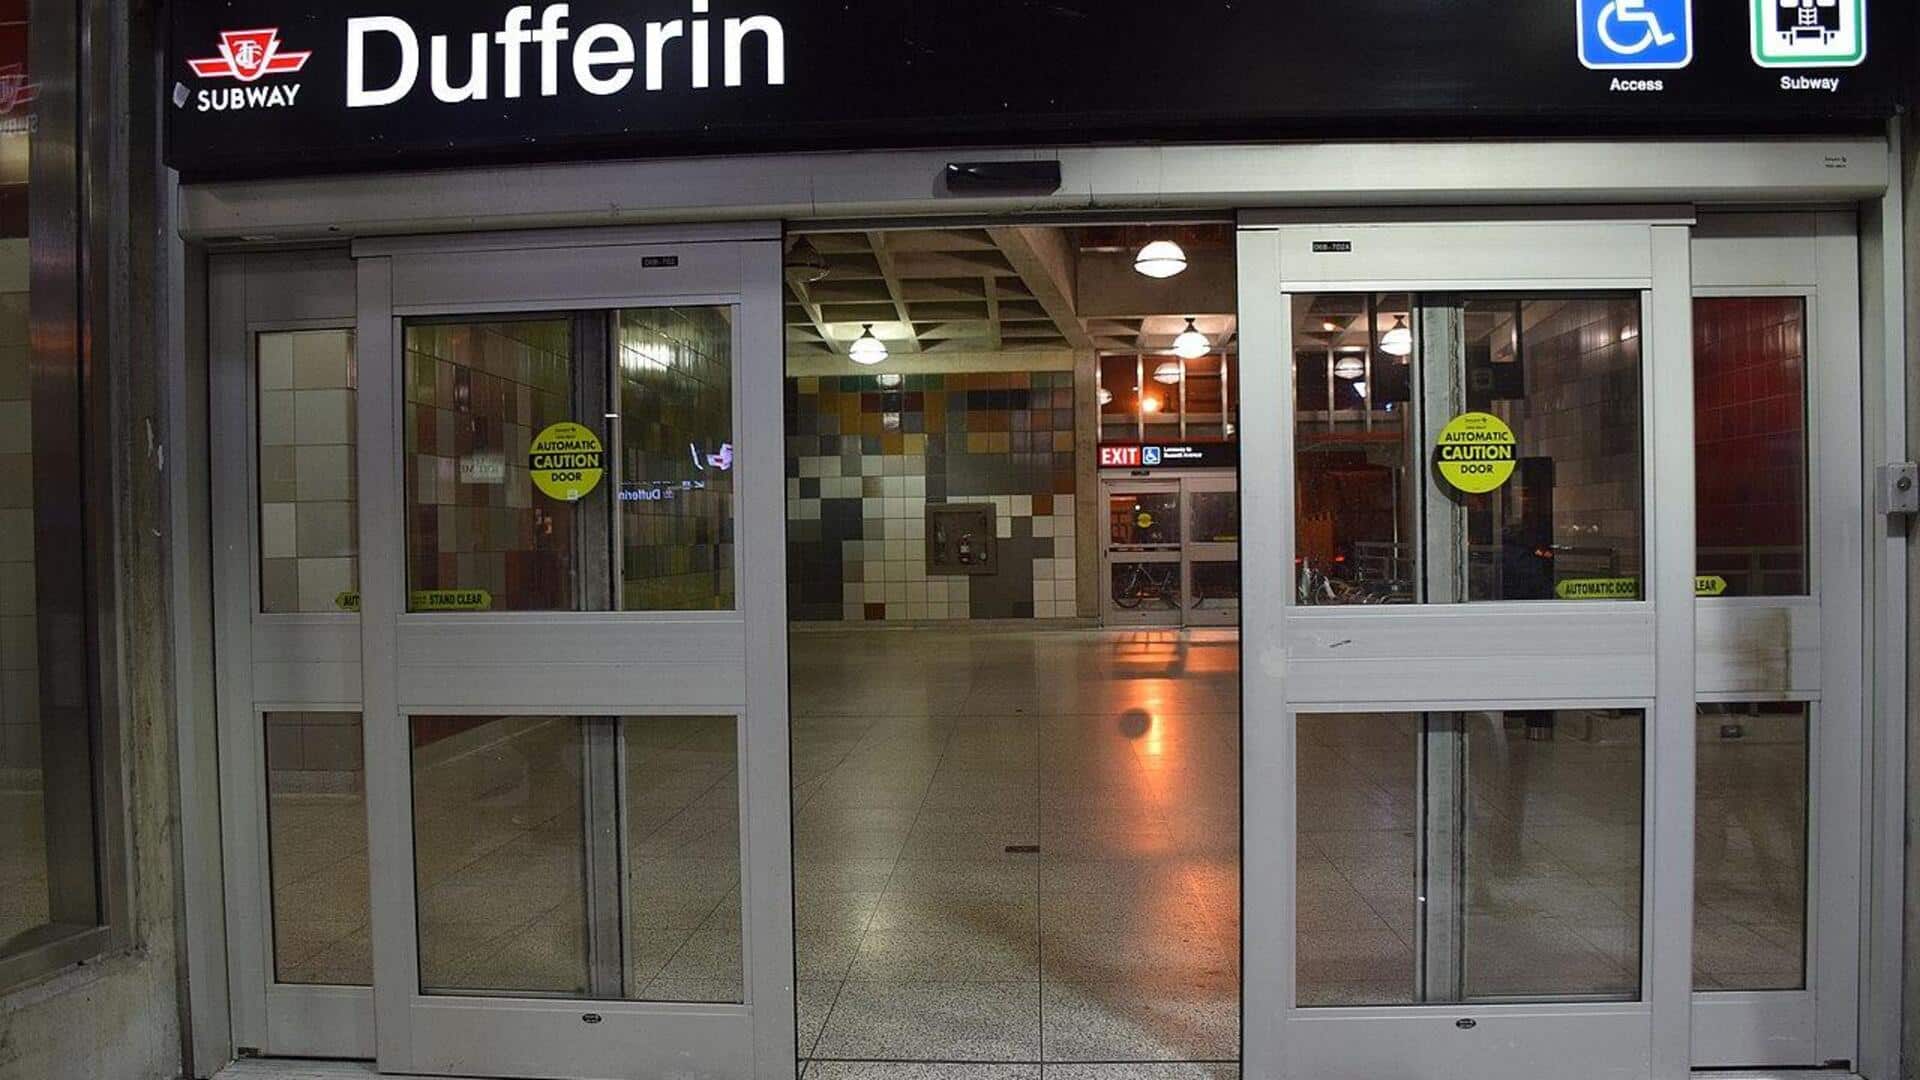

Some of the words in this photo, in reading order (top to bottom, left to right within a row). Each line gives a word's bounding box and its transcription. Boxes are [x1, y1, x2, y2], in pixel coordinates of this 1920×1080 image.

[345, 0, 785, 108] Dufferin
[1610, 77, 1663, 92] Access
[1780, 76, 1839, 92] Subway
[197, 84, 300, 112] SUBWAY
[1445, 431, 1509, 441] AUTOMATIC
[537, 440, 597, 452] AUTOMATIC
[1101, 447, 1138, 465] EXIT
[1441, 446, 1512, 460] CAUTION
[533, 454, 599, 468] CAUTION
[1460, 464, 1494, 474] DOOR
[551, 472, 582, 482] DOOR
[1565, 581, 1614, 594] AUTOMATIC
[1695, 579, 1717, 592] LEAR
[429, 593, 456, 605] STAND
[457, 593, 482, 604] CLEAR
